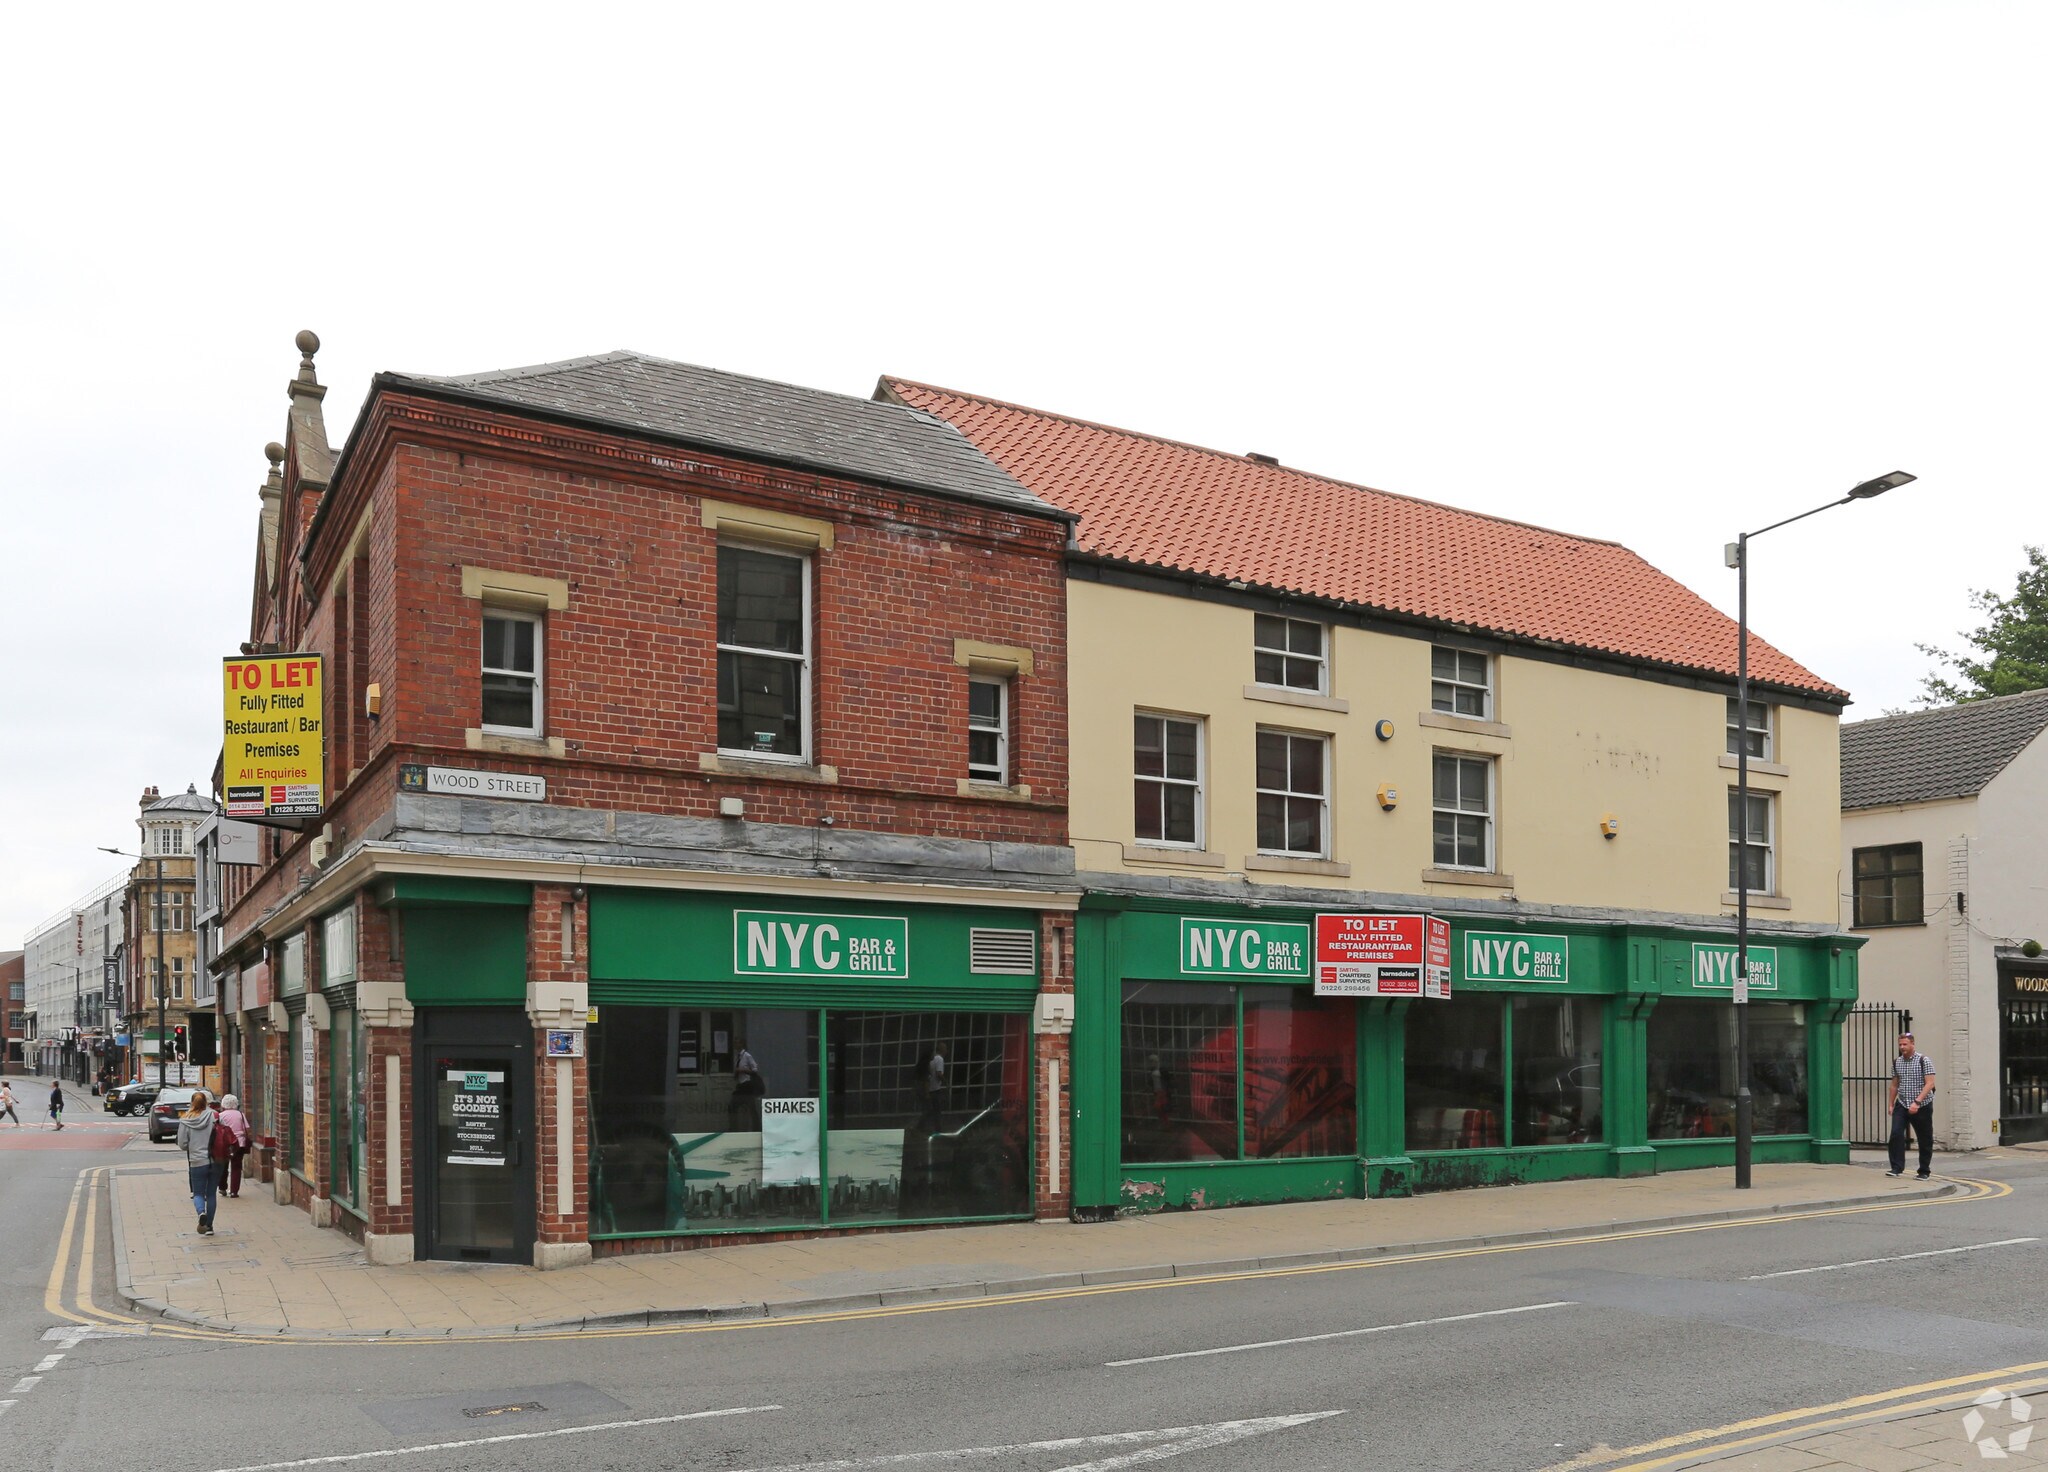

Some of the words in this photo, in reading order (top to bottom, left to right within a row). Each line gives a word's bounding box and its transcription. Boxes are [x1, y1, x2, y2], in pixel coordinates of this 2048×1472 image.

[227, 664, 261, 689] TO
[271, 662, 317, 688] LET
[240, 695, 267, 713] Fully
[271, 693, 304, 709] Fitted
[225, 718, 288, 735] Restaurant
[291, 717, 296, 733] /
[300, 717, 320, 732] Bar
[245, 742, 300, 757] Premises
[240, 769, 253, 779] All
[257, 767, 307, 781] Enquiries
[433, 774, 479, 789] WOOD
[488, 779, 541, 794] STREET
[1343, 920, 1364, 931] TO
[1369, 920, 1398, 931] LET
[1338, 933, 1366, 941] FULLY
[748, 921, 840, 970] NYC
[849, 938, 880, 955] BAR
[884, 939, 896, 955] &
[1190, 927, 1261, 969] NYC
[1267, 941, 1289, 956] BAR
[1292, 943, 1301, 956] &
[1328, 942, 1412, 950] RESTAURANT/BAR
[849, 955, 897, 971] GRILL
[1267, 956, 1301, 971] GRILL
[1472, 939, 1529, 976] NYC
[1534, 951, 1552, 964] BAR
[1554, 952, 1561, 965] &
[1534, 964, 1561, 977] GRILL
[1749, 962, 1764, 973] BAR
[1765, 962, 1771, 973] &
[1749, 973, 1771, 985] GRILL
[466, 1075, 486, 1084] NYC
[454, 1094, 473, 1103] IT'S
[475, 1095, 497, 1104] NOT
[452, 1103, 499, 1113] GOODBYE
[764, 1101, 815, 1114] SHAKES
